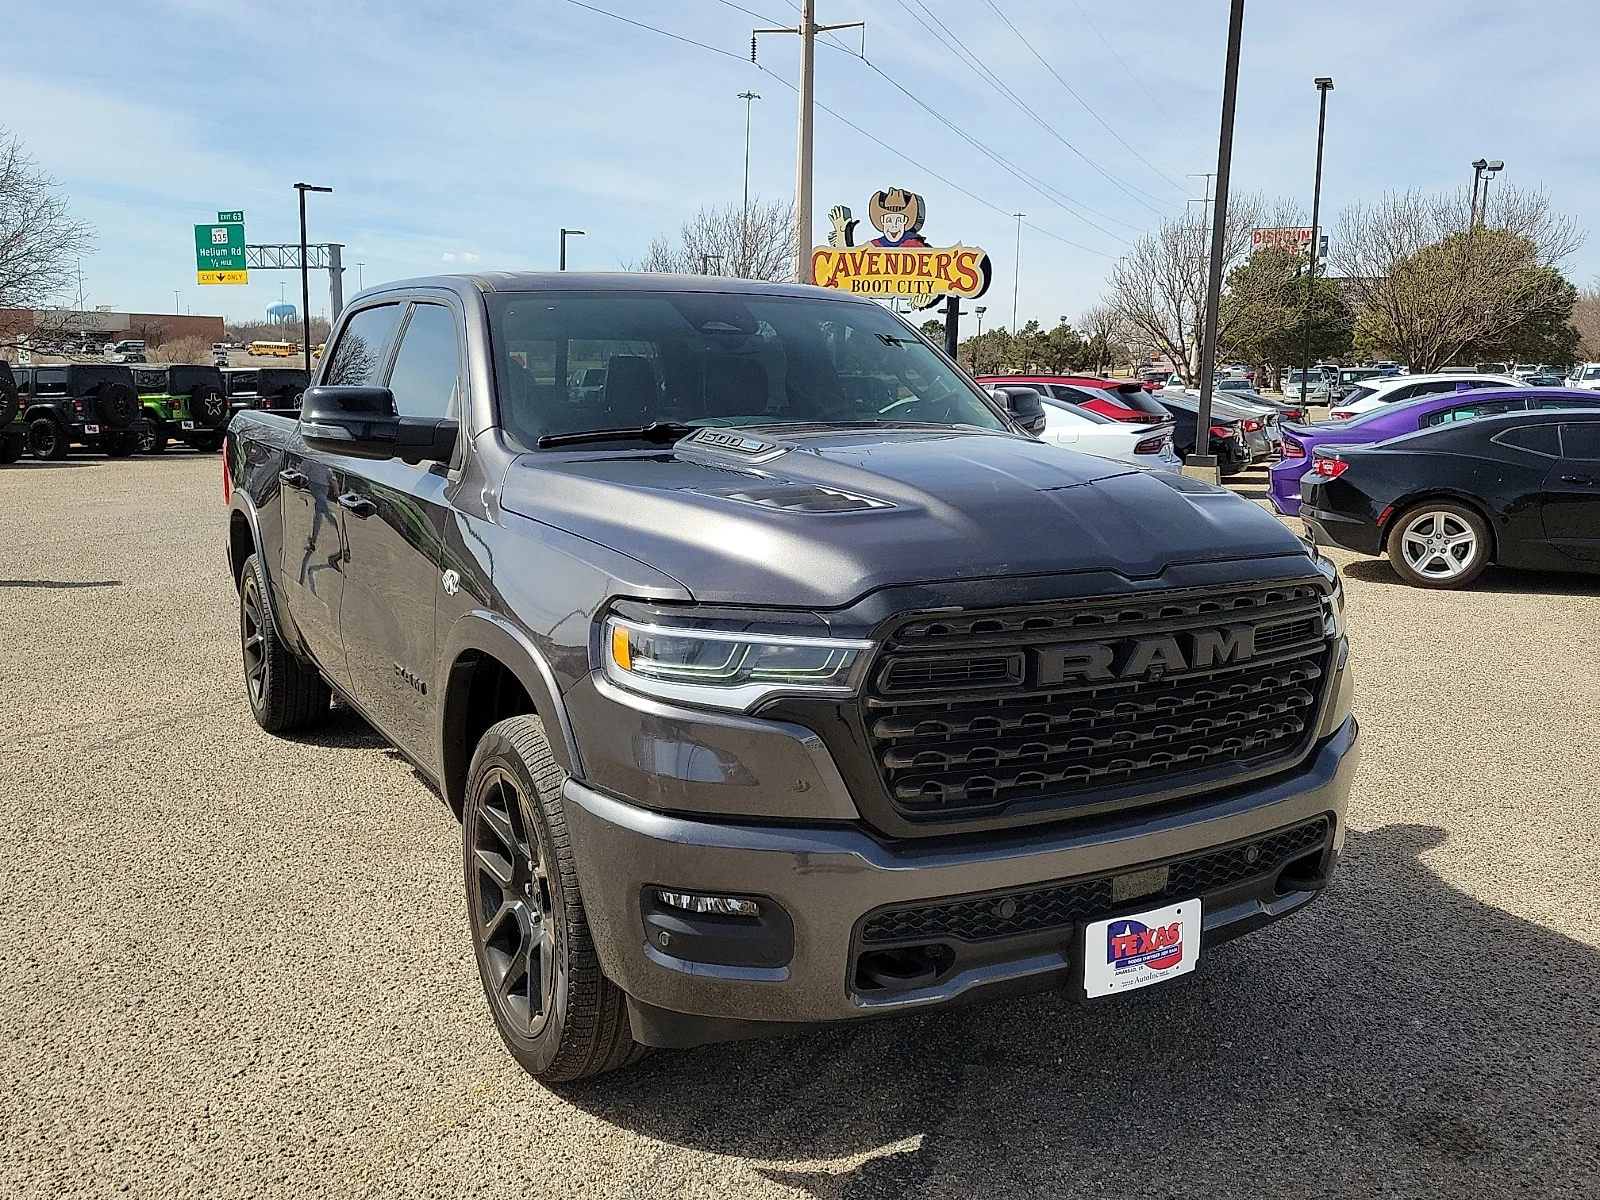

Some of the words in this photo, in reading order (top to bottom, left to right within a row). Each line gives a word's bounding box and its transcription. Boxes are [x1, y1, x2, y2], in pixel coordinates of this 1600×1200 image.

[232, 212, 242, 221] 63
[212, 233, 227, 243] 335
[200, 247, 228, 257] Helium
[231, 247, 242, 256] Rd
[811, 247, 979, 292] CAVENDER'S
[851, 279, 893, 294] BOOT
[897, 280, 936, 294] CITY
[19, 350, 30, 361] 45
[699, 430, 743, 446] 1500
[1034, 627, 1252, 686] RAM
[1111, 921, 1180, 959] TEXAS
